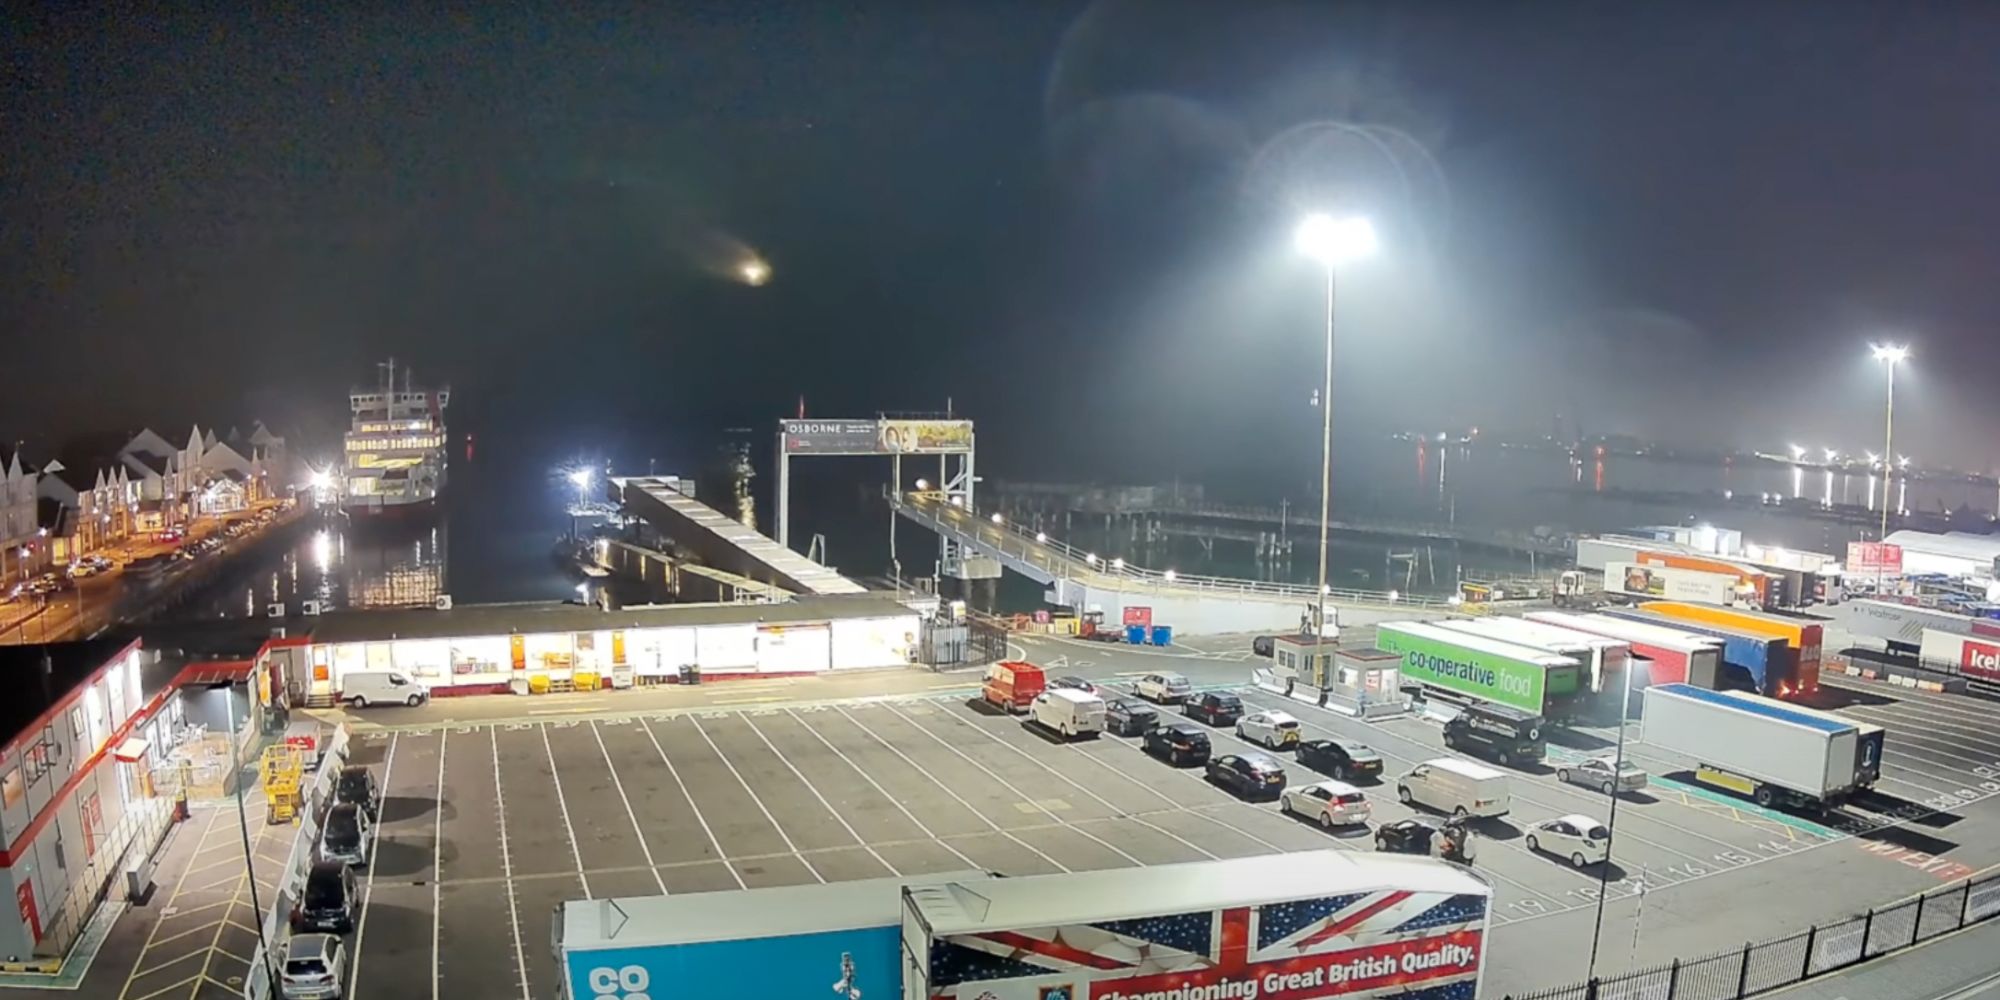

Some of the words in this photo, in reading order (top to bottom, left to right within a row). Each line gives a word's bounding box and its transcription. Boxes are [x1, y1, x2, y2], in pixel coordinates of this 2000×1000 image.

[789, 424, 841, 433] OSBORNE
[1409, 650, 1495, 686] co-operative
[1500, 668, 1531, 697] food
[1758, 840, 1793, 854] 14
[1714, 850, 1751, 866] 15
[1667, 863, 1707, 877] 16
[1566, 888, 1618, 902] 18
[1508, 900, 1546, 915] 19
[1264, 968, 1323, 993] Great
[1329, 956, 1397, 981] British
[1402, 943, 1475, 973] Quality.
[589, 965, 649, 993] CO
